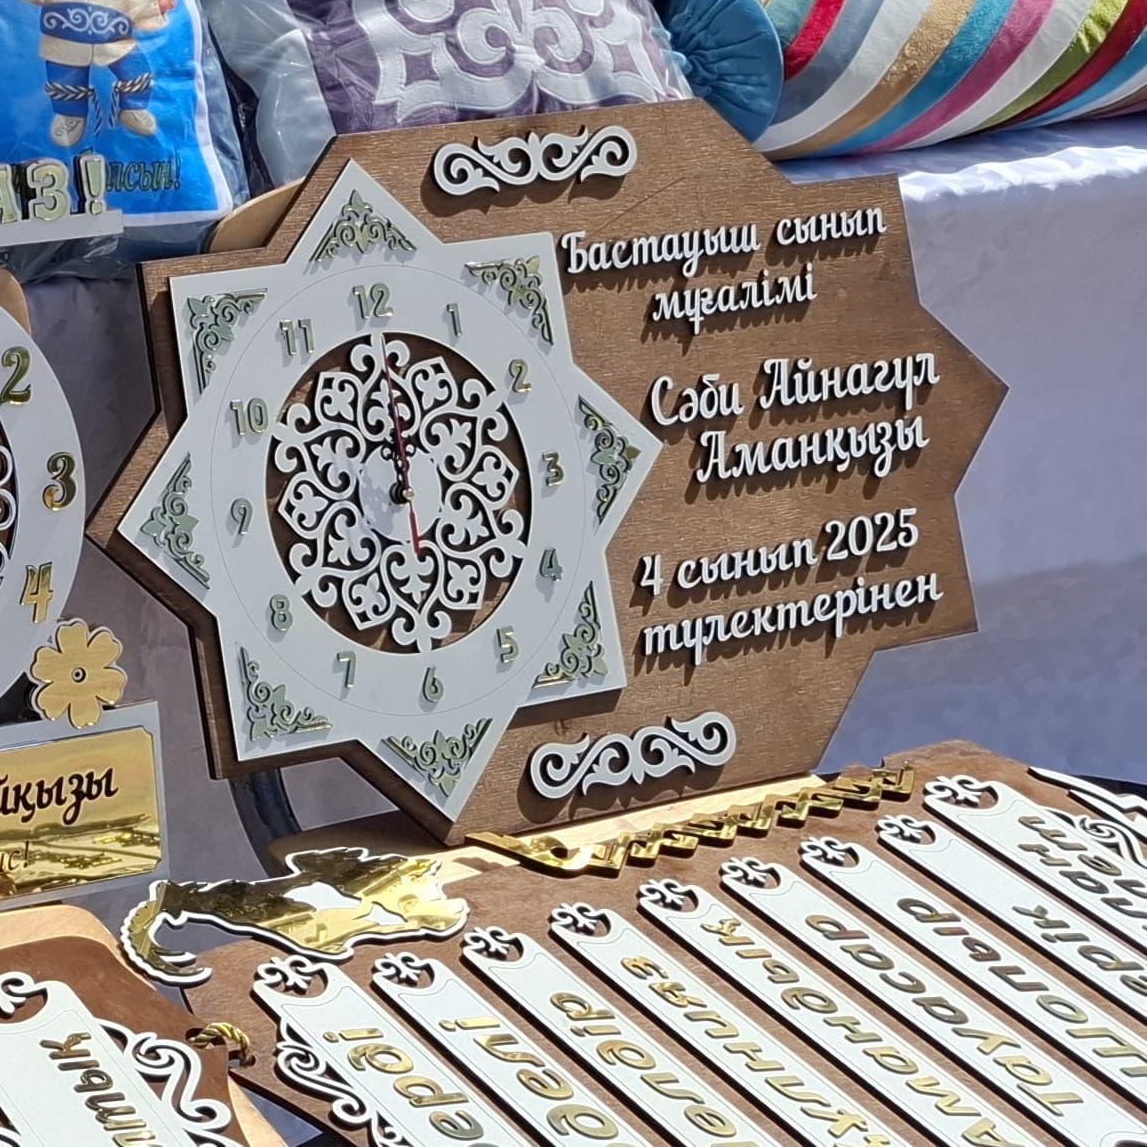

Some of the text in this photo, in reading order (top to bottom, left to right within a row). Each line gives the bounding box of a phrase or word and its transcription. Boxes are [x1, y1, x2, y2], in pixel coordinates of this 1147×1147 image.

[561, 206, 886, 277] Бастауыш сынып
[353, 283, 394, 319] 12
[446, 303, 463, 337] 1
[652, 263, 818, 335] мұғалімі
[280, 318, 314, 356] 11
[0, 346, 32, 405] 2
[509, 359, 532, 393] 2
[651, 353, 940, 427] Сәби Айнагүл
[230, 398, 268, 436] 10
[542, 452, 564, 486] 3
[696, 415, 930, 483] Аманқызы
[43, 452, 76, 510] 3
[231, 498, 253, 535] 9
[539, 548, 563, 581] 4
[640, 508, 919, 596] 4 сынып 2025
[20, 562, 54, 623] 4
[269, 594, 293, 632] 8
[643, 572, 944, 666] түлектерінен
[336, 652, 357, 689] 7
[496, 627, 519, 663] 5
[422, 665, 444, 702] 6
[805, 915, 1084, 1117] Тауасар
[323, 1027, 501, 1147] ерді
[439, 1016, 638, 1147] делі
[550, 992, 759, 1147] өлдір
